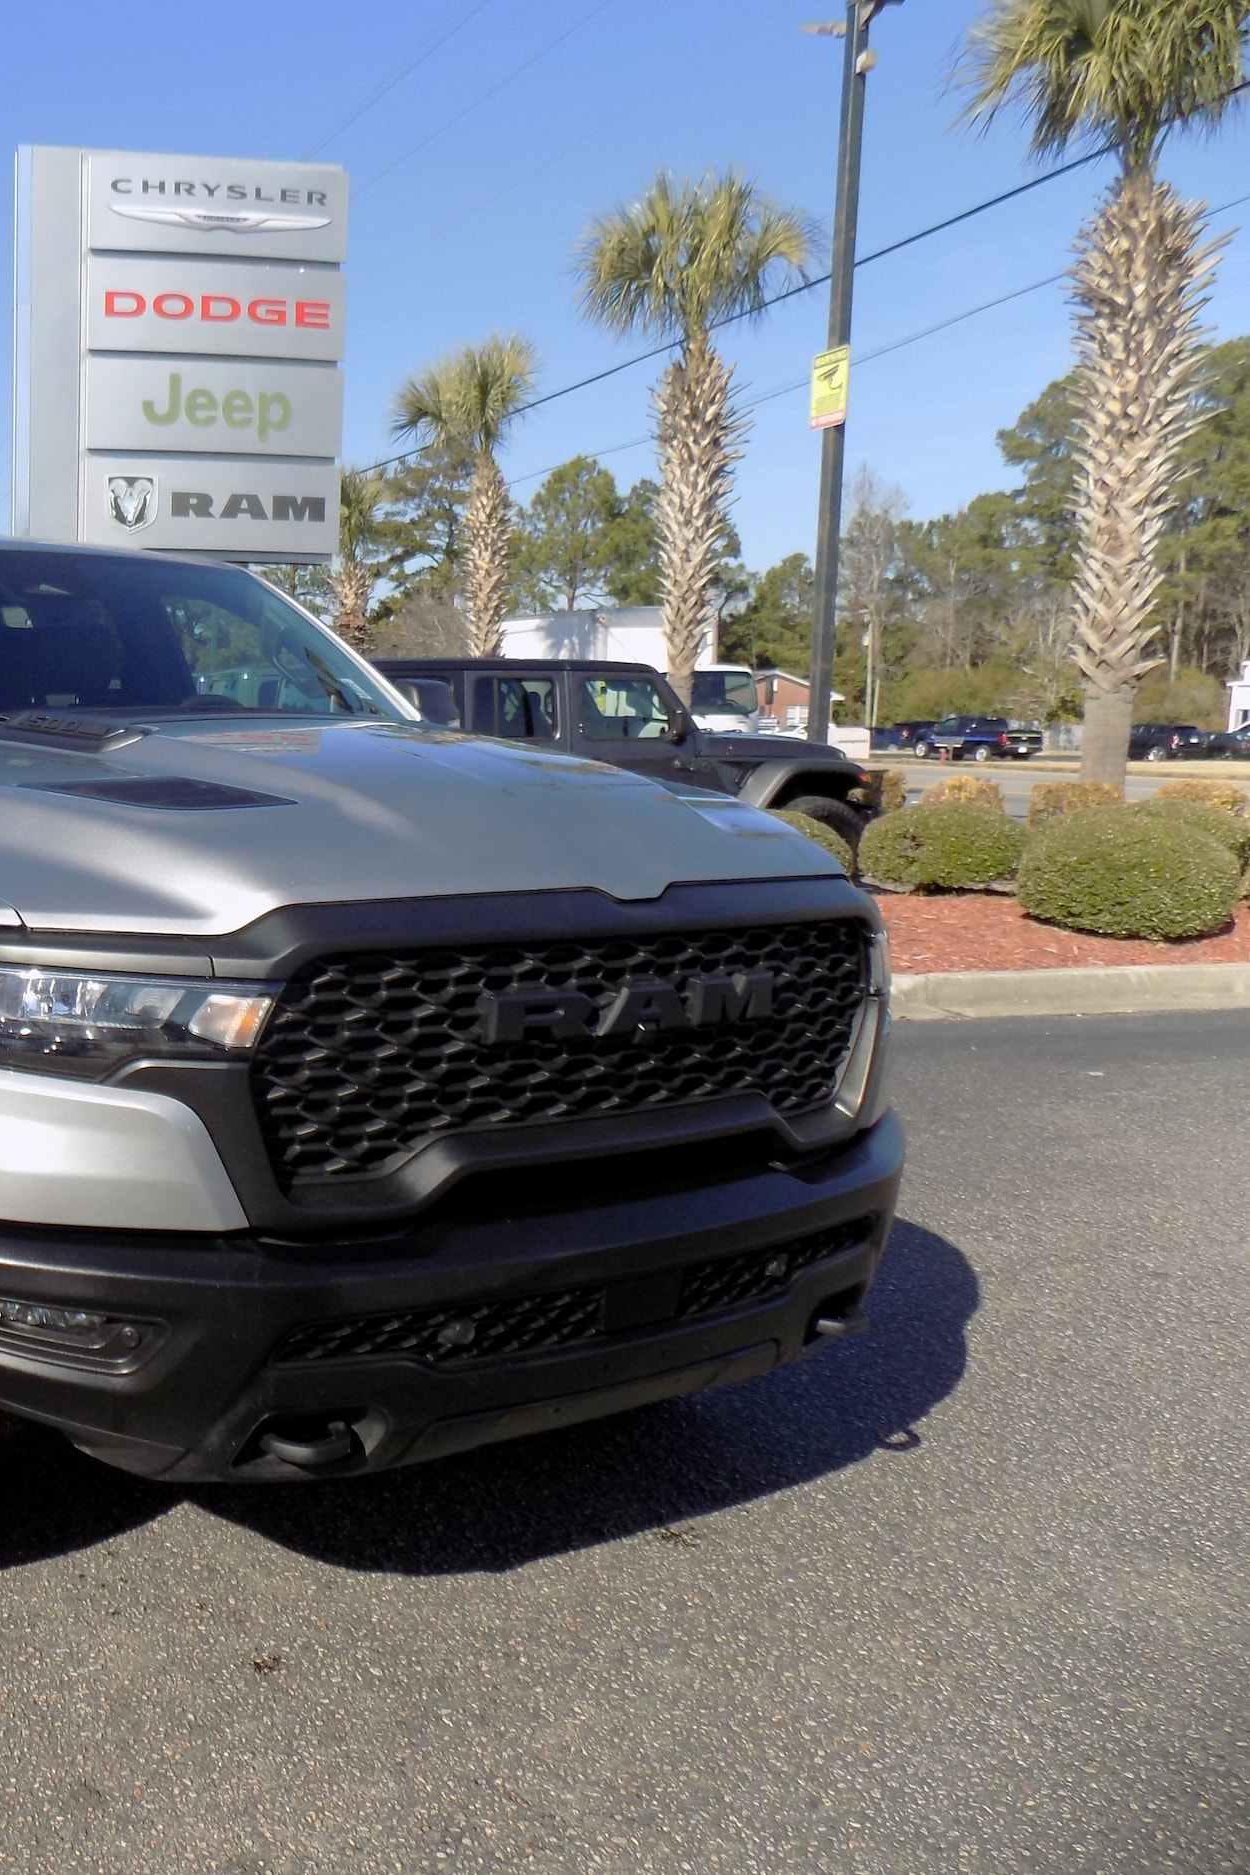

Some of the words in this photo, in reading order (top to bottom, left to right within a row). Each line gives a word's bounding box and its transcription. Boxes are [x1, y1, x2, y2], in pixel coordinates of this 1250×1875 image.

[110, 178, 327, 206] CHRYSLER
[104, 290, 331, 329] DODGE
[142, 373, 292, 441] Jeep
[171, 491, 326, 522] RAM
[478, 971, 774, 1044] RAM
